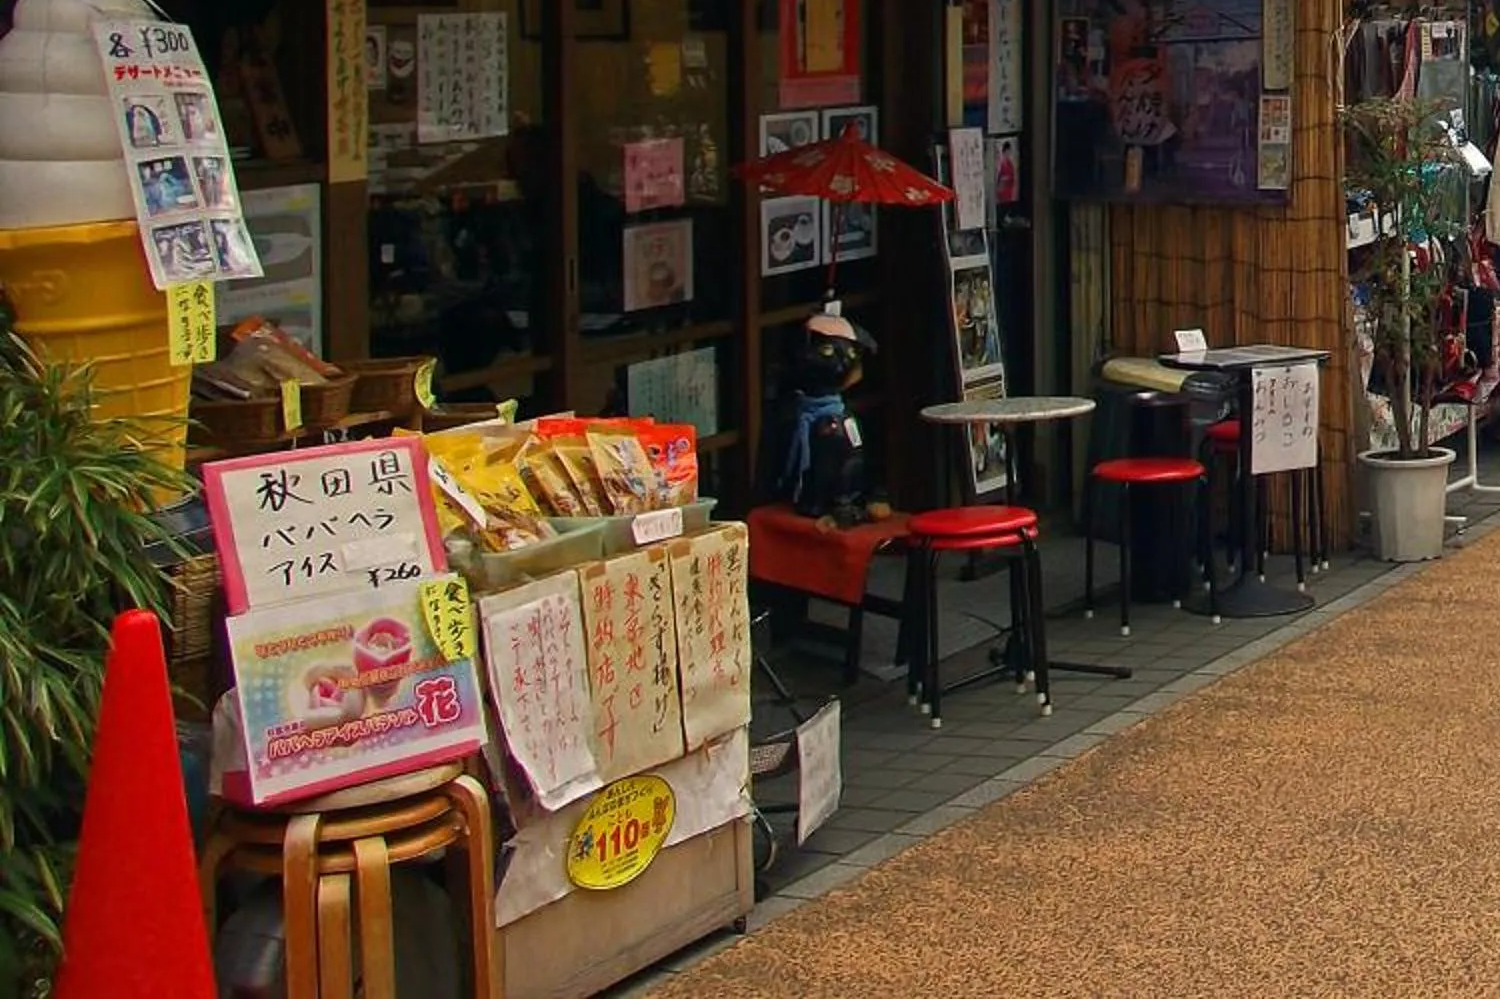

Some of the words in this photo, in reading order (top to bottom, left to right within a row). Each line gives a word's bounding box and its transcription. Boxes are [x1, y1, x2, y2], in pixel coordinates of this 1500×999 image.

[140, 26, 190, 59] ¥300
[113, 63, 206, 82] デザートメニュー
[257, 453, 410, 512] 秋田県
[263, 507, 397, 548] ババヘラ
[269, 552, 339, 587] アイス
[416, 675, 461, 728] 花
